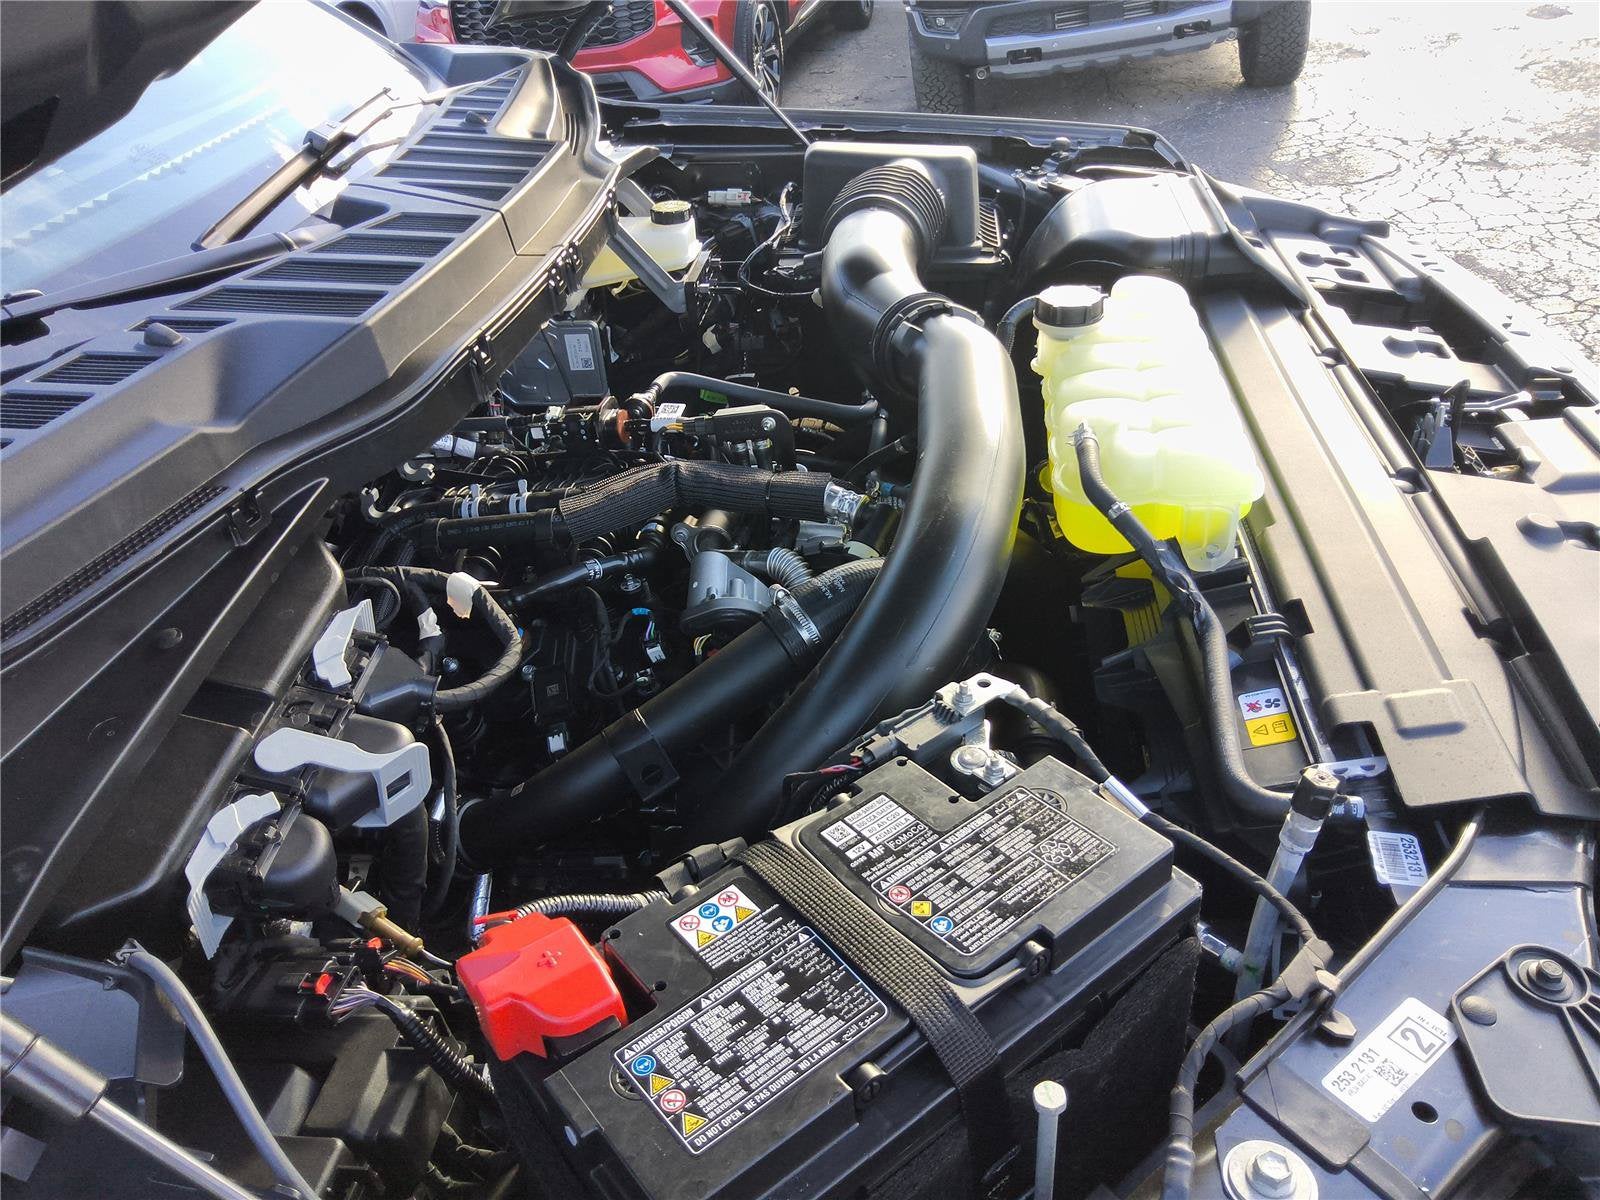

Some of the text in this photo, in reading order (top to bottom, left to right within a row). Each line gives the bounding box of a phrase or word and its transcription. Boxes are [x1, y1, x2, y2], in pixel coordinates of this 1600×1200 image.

[889, 811, 900, 822] C20
[943, 812, 994, 845] PELIGRO/VENENO
[852, 844, 866, 854] 12V
[889, 823, 925, 849] FoMoCo
[868, 844, 886, 859] MF
[1400, 836, 1424, 878] 2532131
[884, 849, 938, 883] DANGER/POISON
[1001, 885, 1023, 901] CONTRA
[1020, 867, 1048, 887] DERRAMES
[950, 908, 991, 937] NON-SPILLABLE
[956, 912, 999, 941] Lead Acid Battery
[967, 940, 982, 951] ANTI
[707, 959, 767, 1001] PELIGRO/VENENO
[740, 971, 773, 994] PROTEJA LOS
[689, 1002, 724, 1029] SE PROTÉGER
[694, 1023, 706, 1033] LES
[727, 1000, 740, 1011] GAZ
[738, 1018, 747, 1026] LA
[771, 1015, 782, 1024] NO
[630, 1007, 695, 1053] DANGER/POISON
[651, 1028, 687, 1054] SHIELD EYES.
[1400, 1027, 1436, 1056] 2
[656, 1037, 685, 1059] EXPLOSIVE
[660, 1043, 689, 1064] GASES CAN
[714, 1048, 734, 1065] ÉVITEZ
[797, 1037, 840, 1070] NO LA ABRA.
[664, 1055, 682, 1069] CAUSE
[668, 1053, 696, 1074] BLINDNESS
[673, 1070, 682, 1079] OR
[1331, 1070, 1356, 1092] 253
[1352, 1048, 1380, 1074] 2131
[680, 1079, 691, 1088] NO
[696, 1088, 721, 1108] SULFURIC
[717, 1081, 731, 1093] ACID
[744, 1067, 799, 1110] NE PAS OUVRIR.
[702, 1099, 720, 1114] CAUSE
[693, 1107, 744, 1146] DO NOT OPEN.
